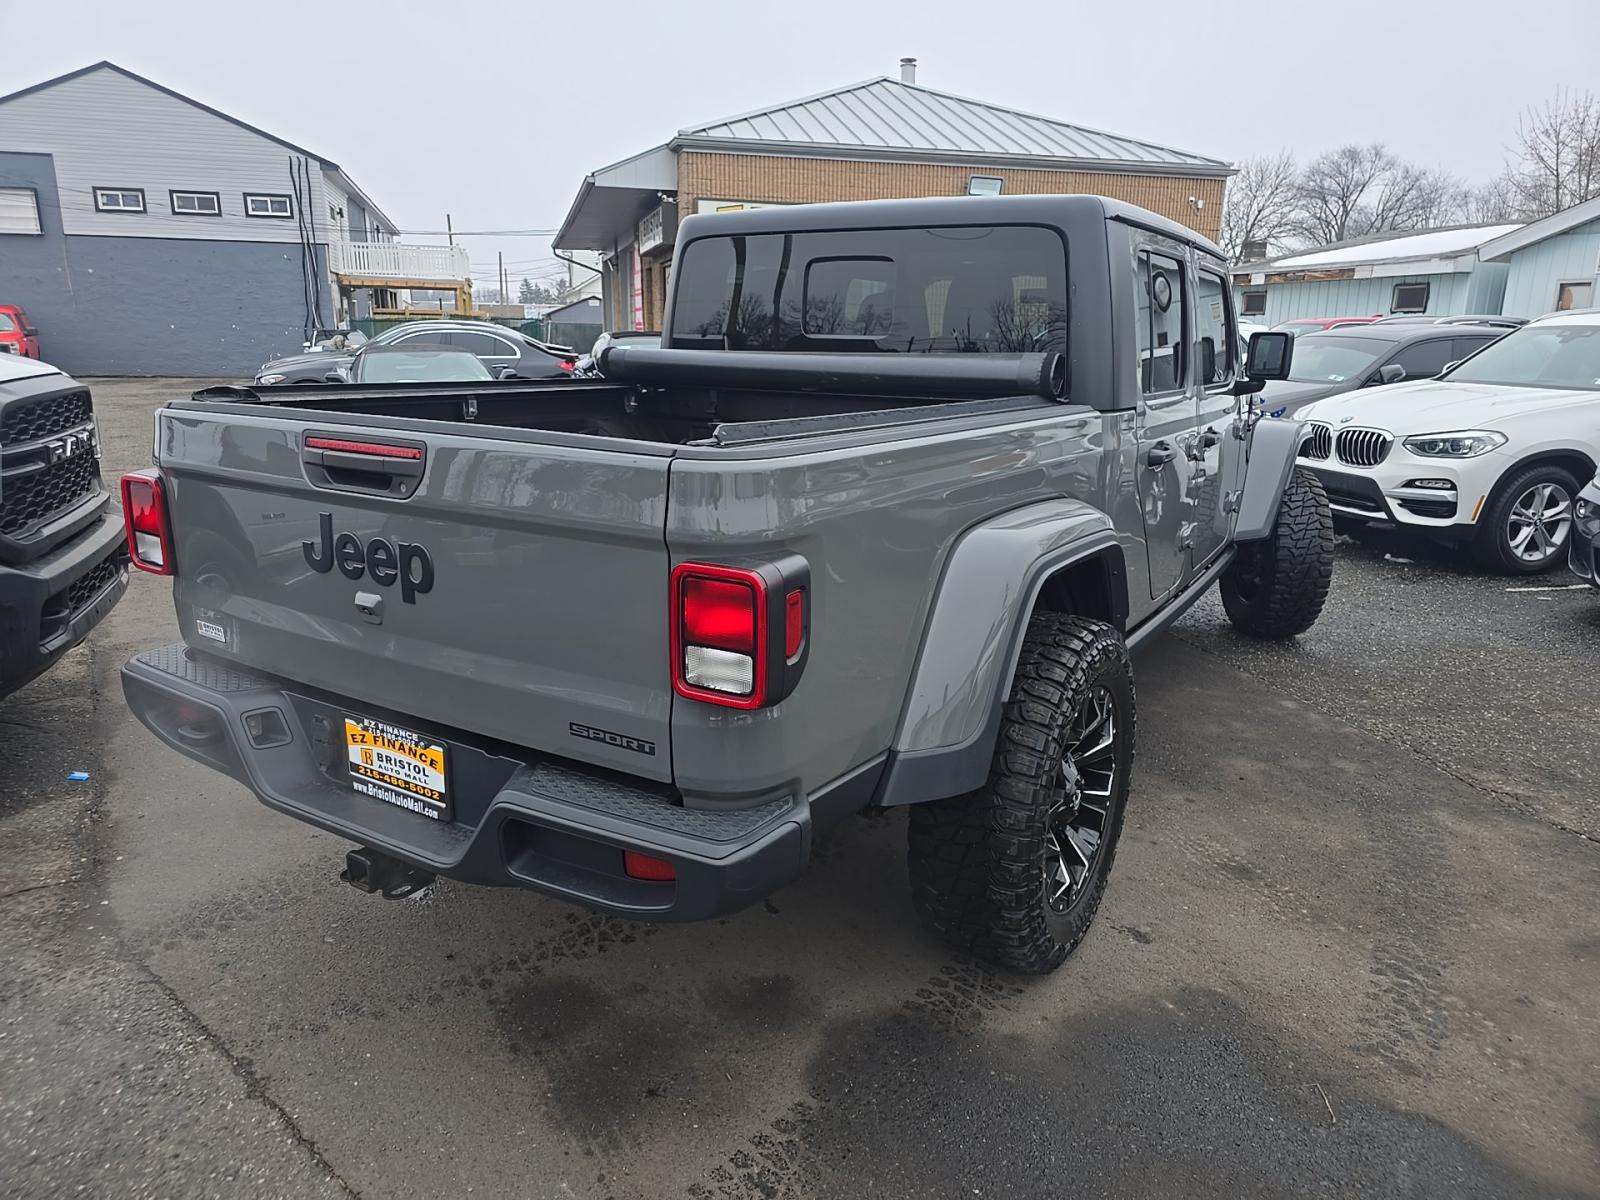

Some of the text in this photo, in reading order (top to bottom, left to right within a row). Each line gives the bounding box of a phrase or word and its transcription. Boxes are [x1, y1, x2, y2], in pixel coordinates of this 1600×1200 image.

[302, 511, 435, 605] Jeep
[363, 718, 419, 742] EZ FINANCE
[570, 722, 656, 755] SPORT
[350, 733, 439, 770] EZ FINANCE
[376, 752, 430, 778] BRISTOL
[377, 764, 429, 785] AUTO MALL
[352, 781, 439, 819] www.BristolAutoMall.com
